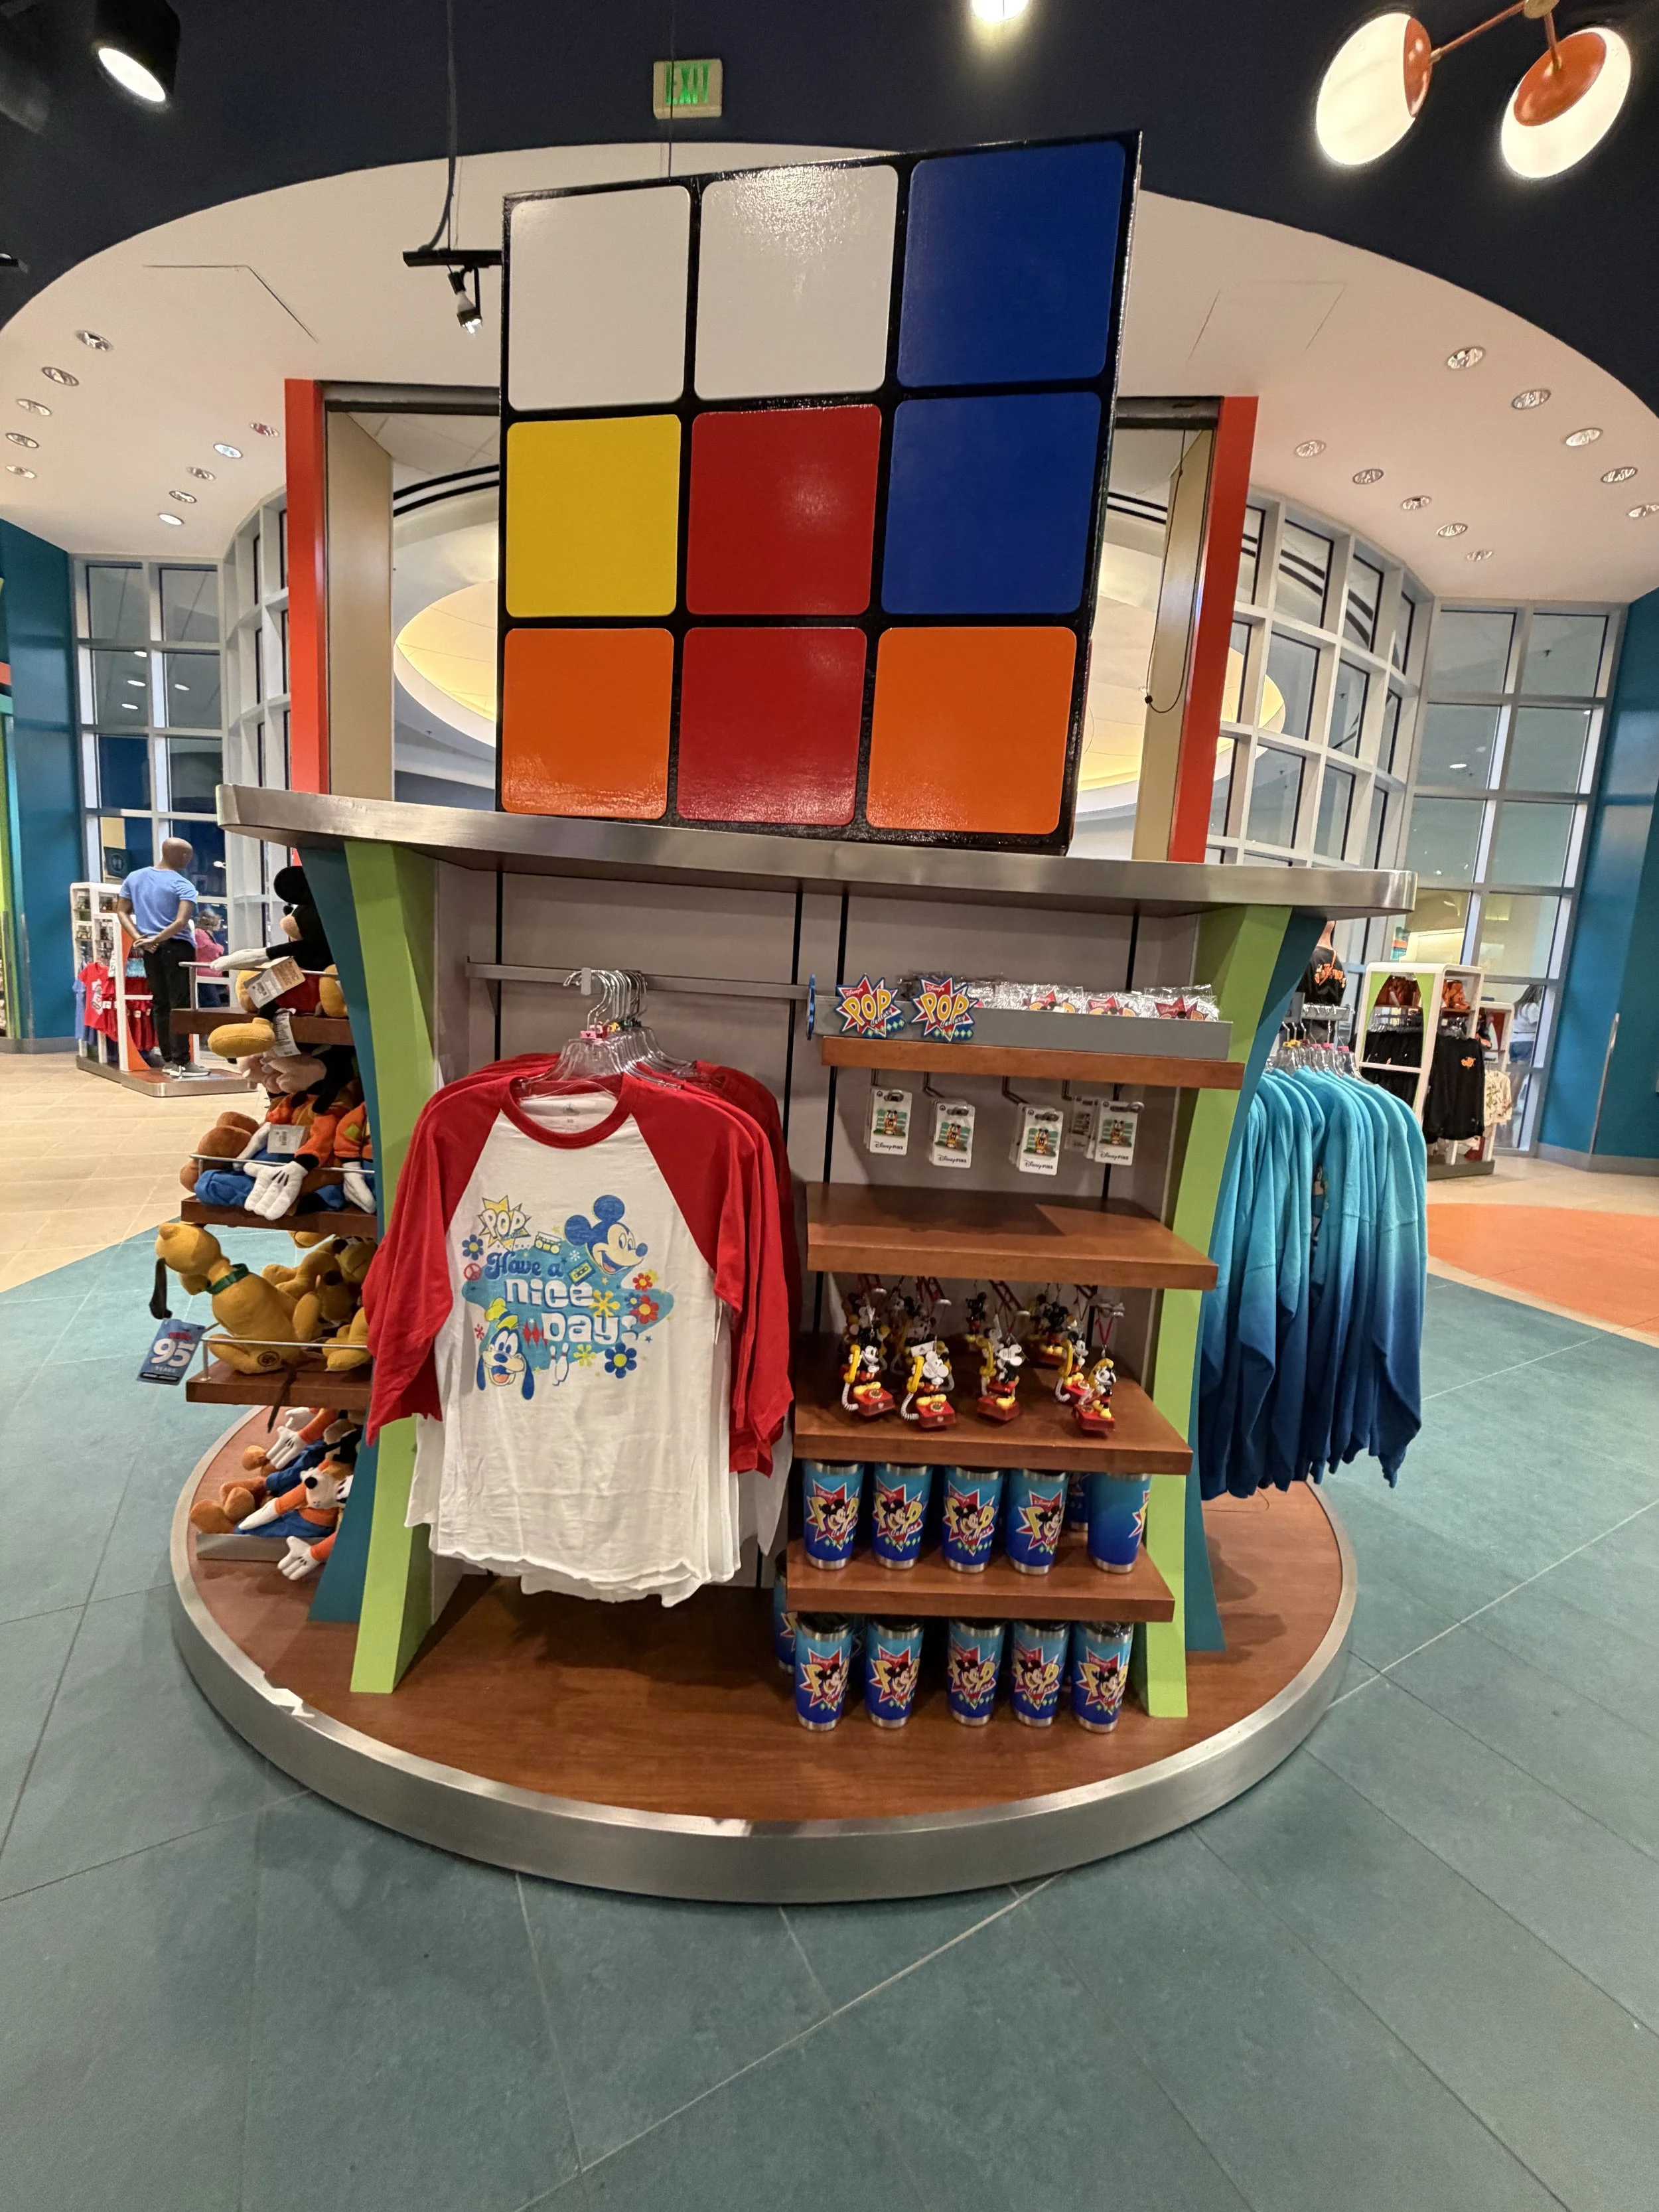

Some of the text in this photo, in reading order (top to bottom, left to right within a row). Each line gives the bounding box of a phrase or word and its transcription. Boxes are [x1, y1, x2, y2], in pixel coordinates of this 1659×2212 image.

[842, 988, 891, 1027] POP
[870, 1008, 893, 1027] Century
[920, 992, 970, 1024] POP
[940, 1015, 966, 1028] Century
[482, 1208, 526, 1239] POP
[486, 1252, 564, 1280] Have a
[541, 1312, 618, 1345] Day
[151, 1338, 196, 1367] 95
